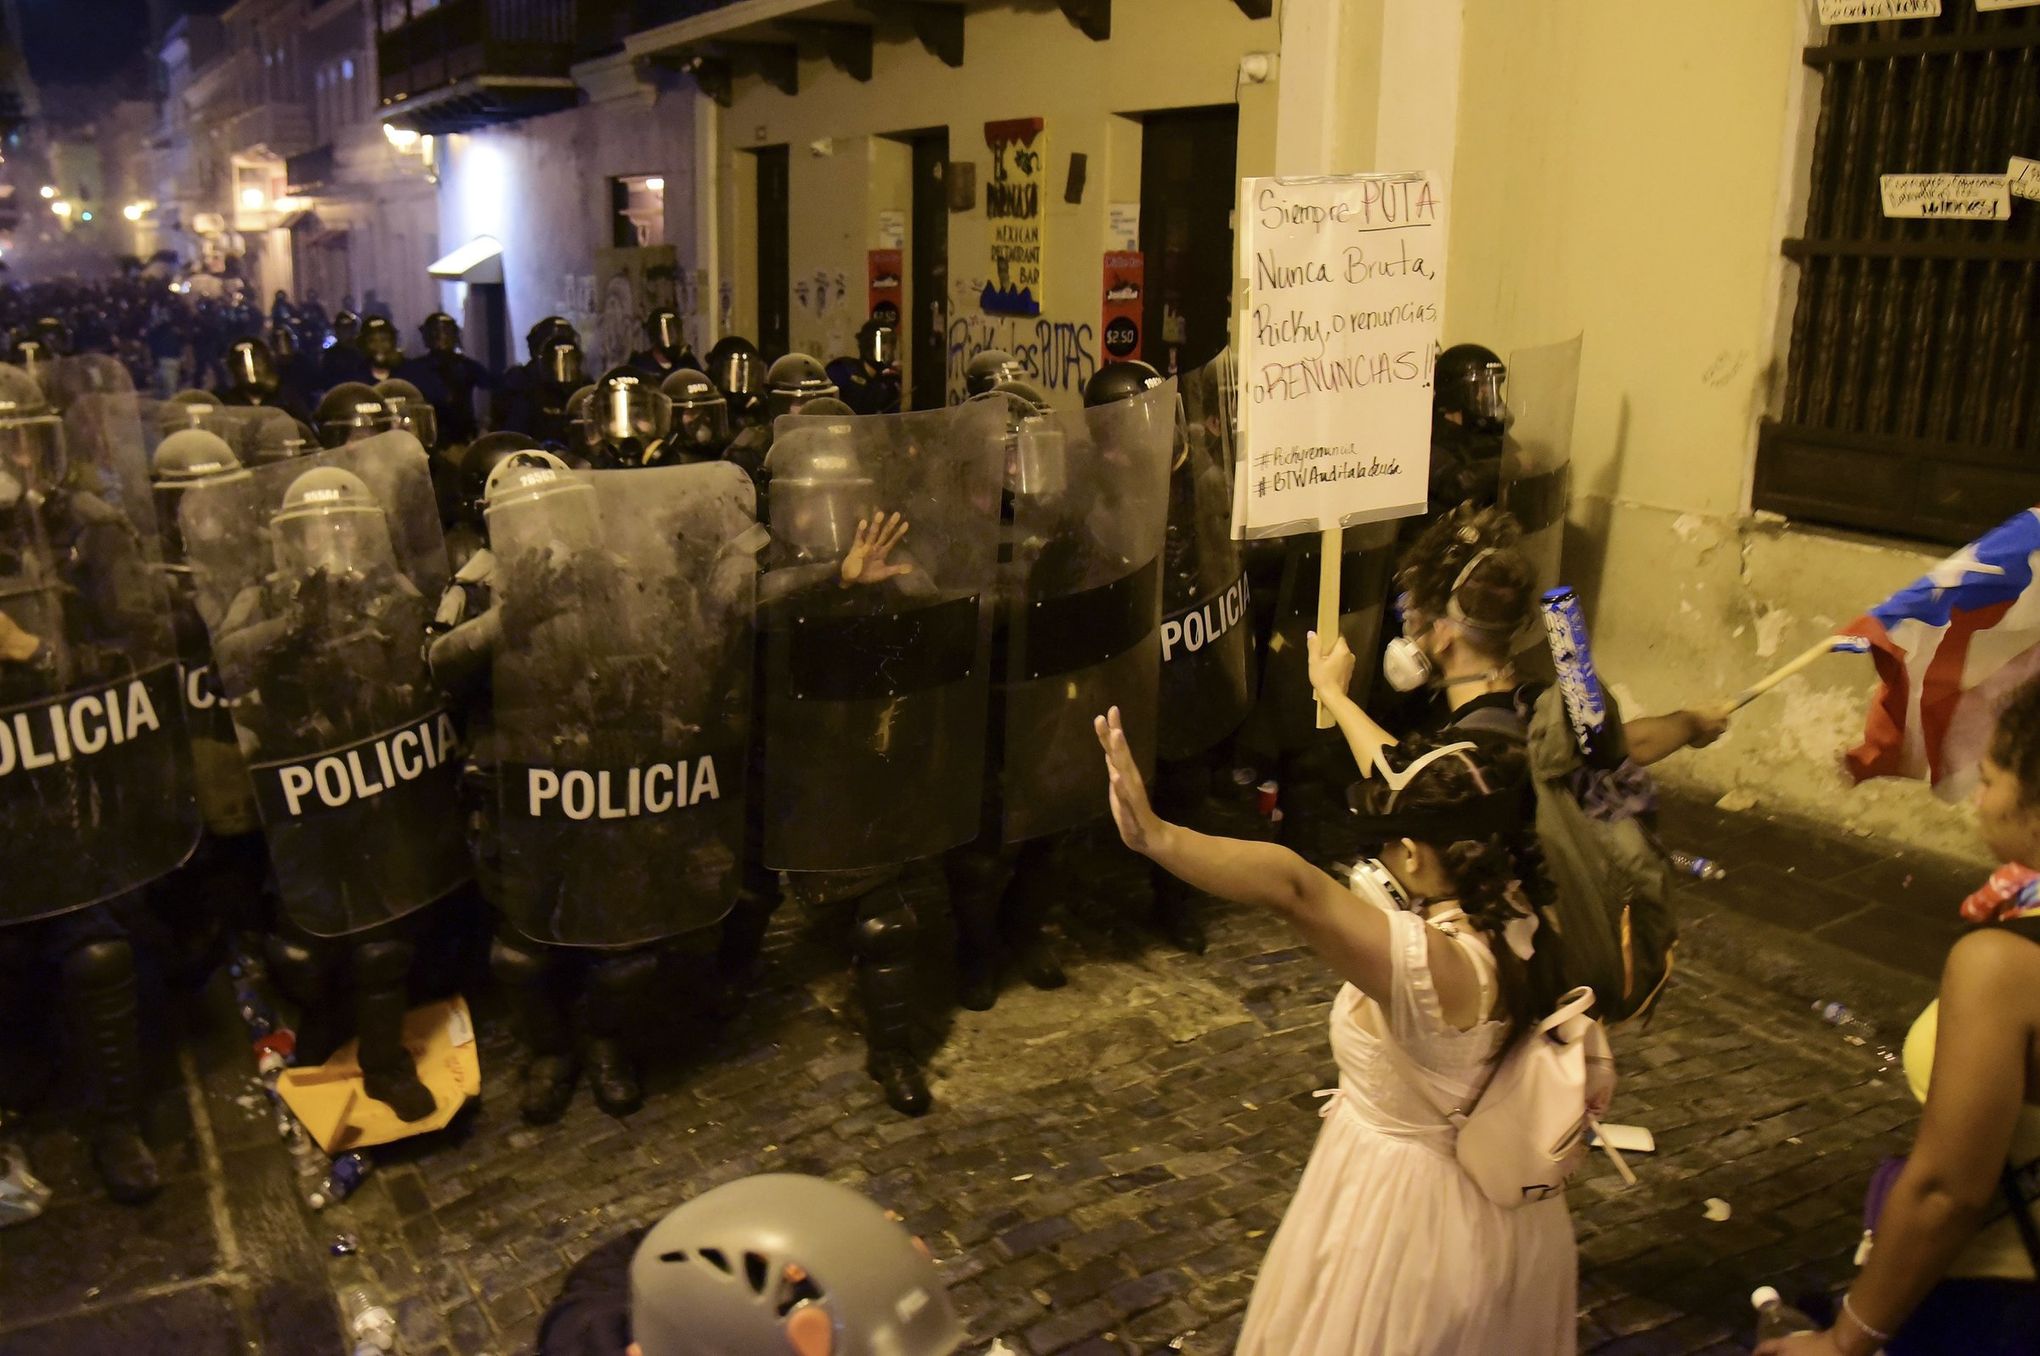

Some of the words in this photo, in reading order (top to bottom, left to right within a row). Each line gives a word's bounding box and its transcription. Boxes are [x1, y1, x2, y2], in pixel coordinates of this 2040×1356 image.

[1259, 188, 1351, 233] Siempre
[1361, 180, 1440, 225] PUTA
[996, 225, 1039, 243] MEXICAN
[1019, 266, 1040, 284] BAR
[1257, 249, 1333, 290] Nunca
[1036, 319, 1098, 396] PUTAS
[1106, 330, 1134, 345] $2.50
[1160, 570, 1251, 662] POLICIA
[279, 712, 459, 816] POLICIA
[528, 754, 720, 820] POLICIA
